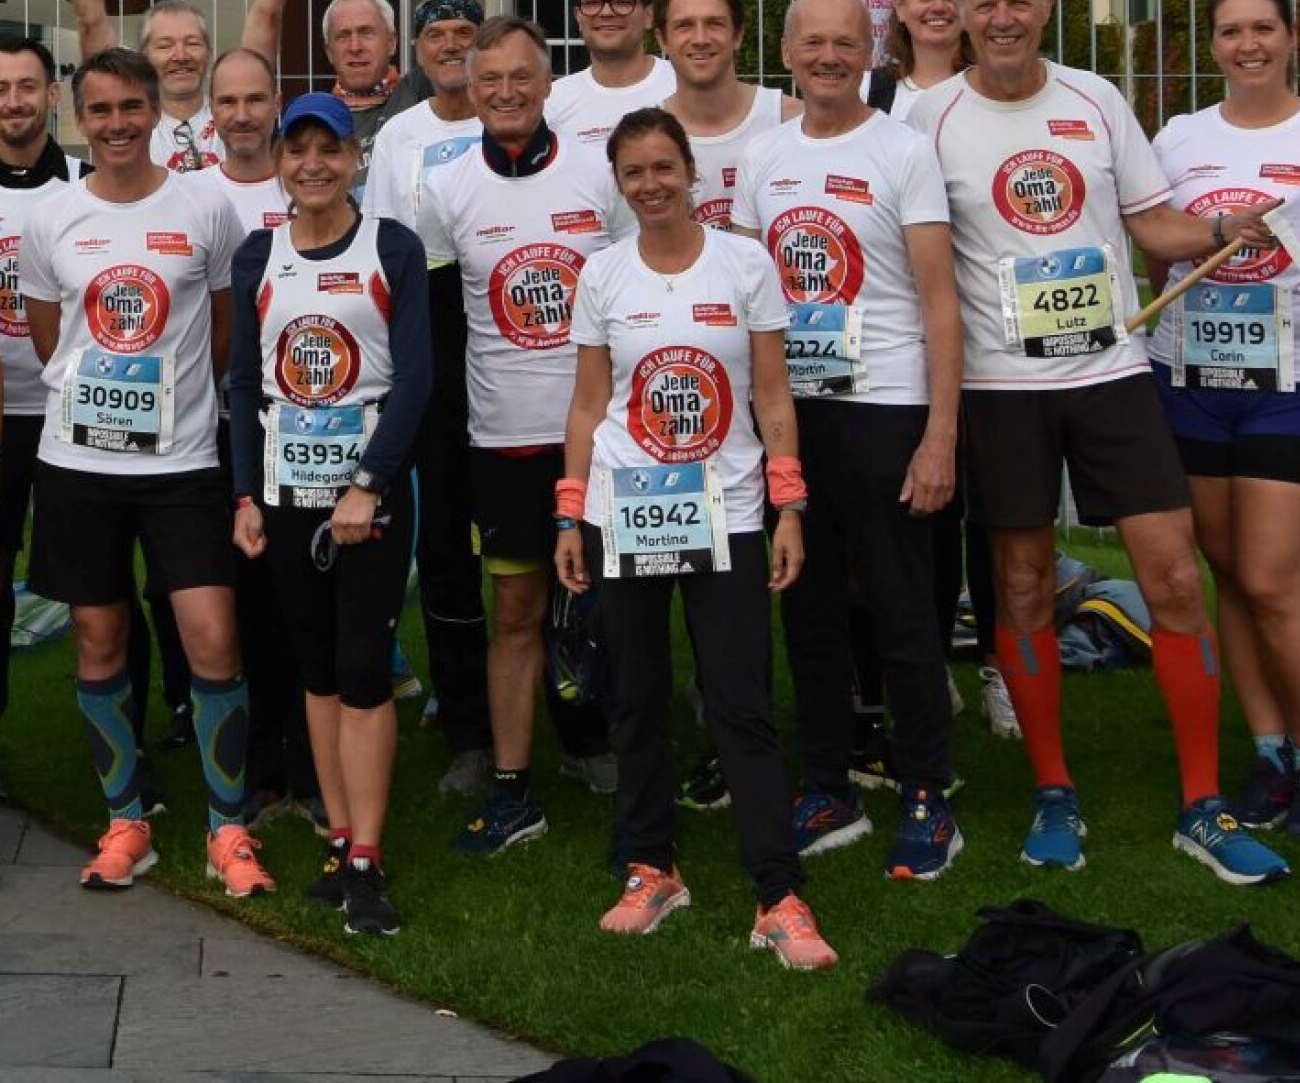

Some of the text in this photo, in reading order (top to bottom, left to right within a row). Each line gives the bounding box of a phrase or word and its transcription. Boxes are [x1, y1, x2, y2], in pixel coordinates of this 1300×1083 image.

[1022, 168, 1053, 182] Jede
[1013, 179, 1056, 199] Oma
[1213, 189, 1252, 205] LAUFE
[1024, 197, 1063, 215] zählt
[791, 232, 828, 249] Jede
[783, 246, 826, 272] Oma
[522, 267, 560, 285] Jede
[113, 284, 143, 297] Jede
[511, 284, 564, 307] Oma
[1033, 283, 1101, 313] 4822
[105, 296, 142, 314] Oma
[110, 314, 145, 331] zählt
[523, 303, 573, 327] zählt
[1056, 317, 1087, 329] Lutz
[300, 334, 331, 348] Jede
[1191, 320, 1265, 344] 19919
[292, 347, 330, 364] Oma
[784, 340, 836, 359] 2224
[639, 360, 654, 378] ICH
[656, 349, 692, 365] LAUFE
[297, 367, 334, 385] zählt
[660, 374, 699, 391] Jede
[77, 384, 155, 412] 30909
[651, 391, 700, 414] Oma
[97, 412, 133, 426] Sören
[659, 414, 705, 436] zählt
[283, 442, 360, 465] 63934
[620, 502, 701, 529] 16942
[636, 533, 689, 547] Martina
